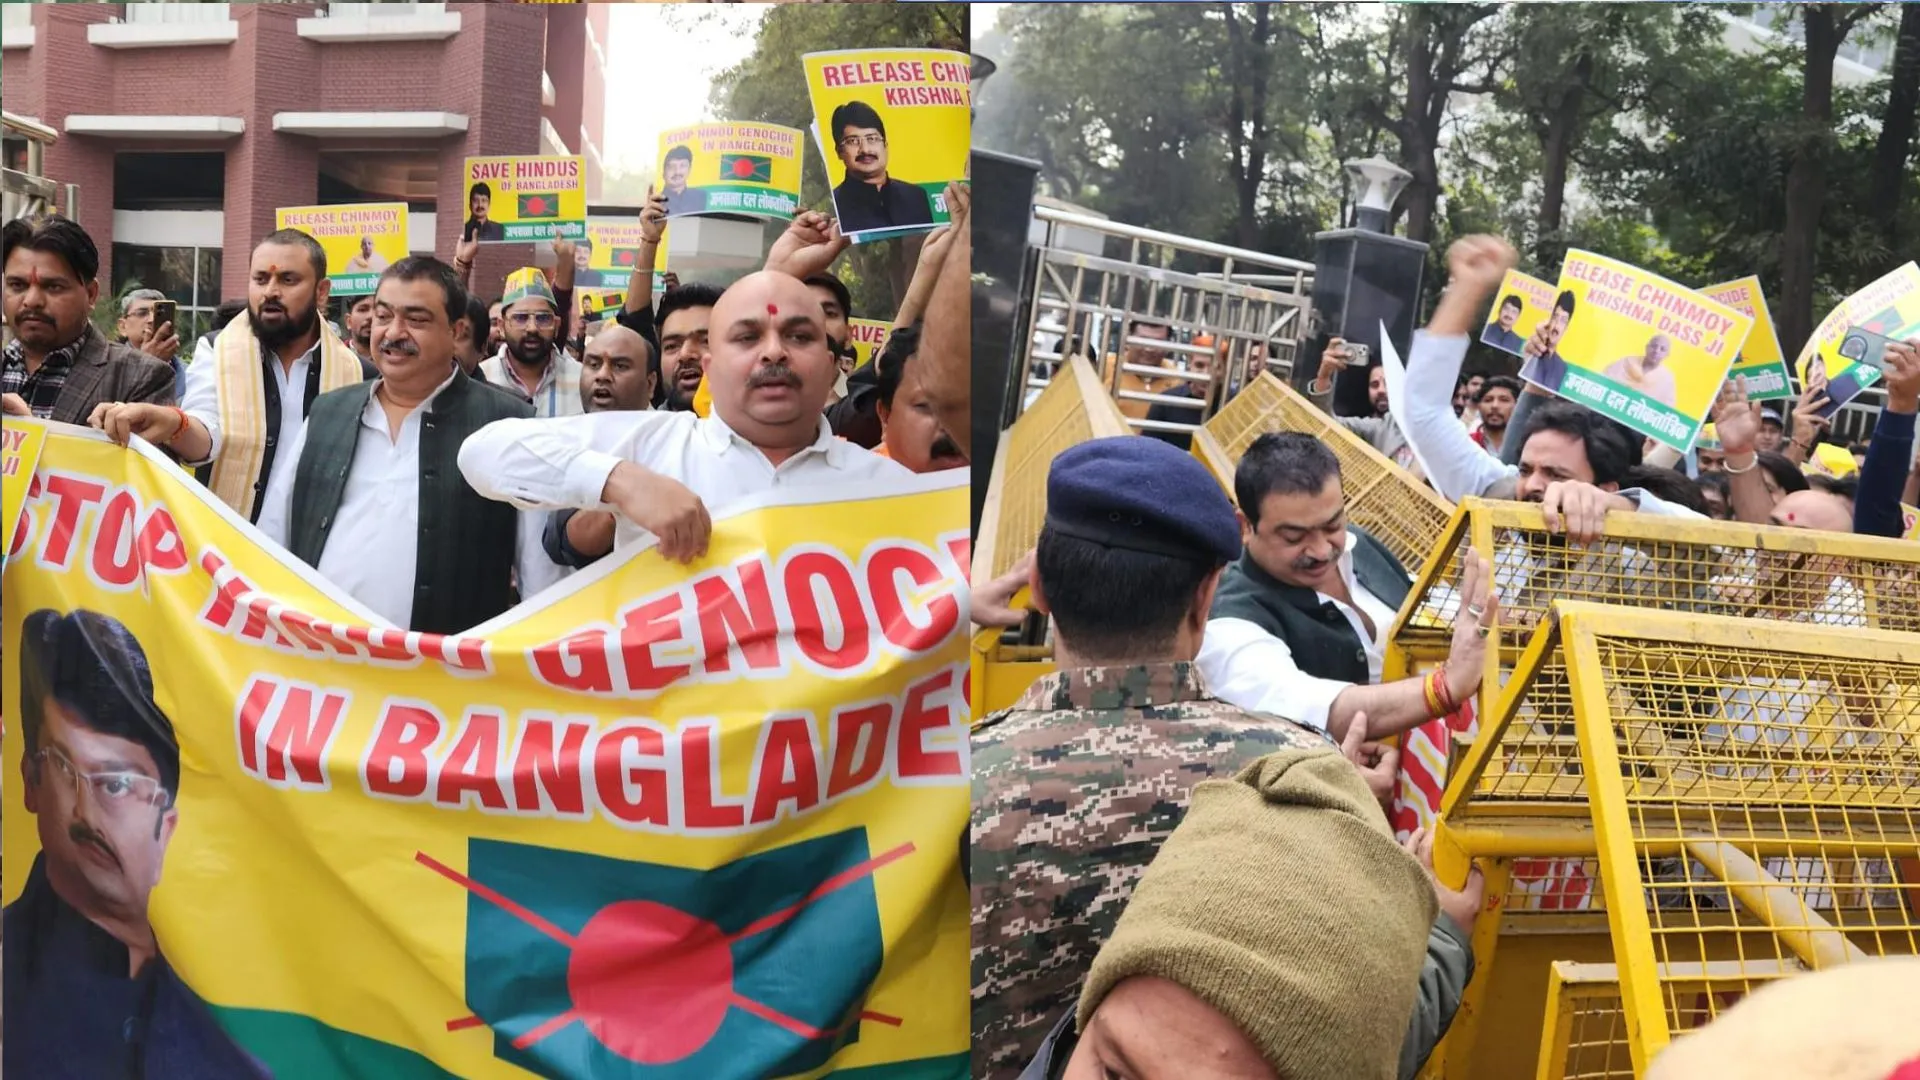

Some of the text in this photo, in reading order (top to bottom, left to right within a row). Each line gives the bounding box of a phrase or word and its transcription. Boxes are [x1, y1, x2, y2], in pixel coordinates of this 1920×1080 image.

[823, 62, 926, 87] RELEASE
[885, 86, 964, 106] KRISHNA
[667, 127, 795, 144] STOP HINDU GENOCIDE
[703, 141, 794, 157] IN BANGLADESH
[471, 161, 578, 180] SAVE HINDUS
[501, 179, 579, 191] OF BANGLADESH
[284, 209, 399, 225] RELEASE CHINMOY
[311, 223, 400, 236] KRISHNA DASS JI
[1566, 260, 1735, 338] RELEASE CHINMOY
[1586, 287, 1653, 326] KRISHNA
[1657, 315, 1702, 347] DASS
[1704, 336, 1725, 357] JI
[849, 324, 885, 343] AVE
[1606, 389, 1629, 412] दल
[3, 456, 20, 476] JI
[239, 679, 345, 784] IN
